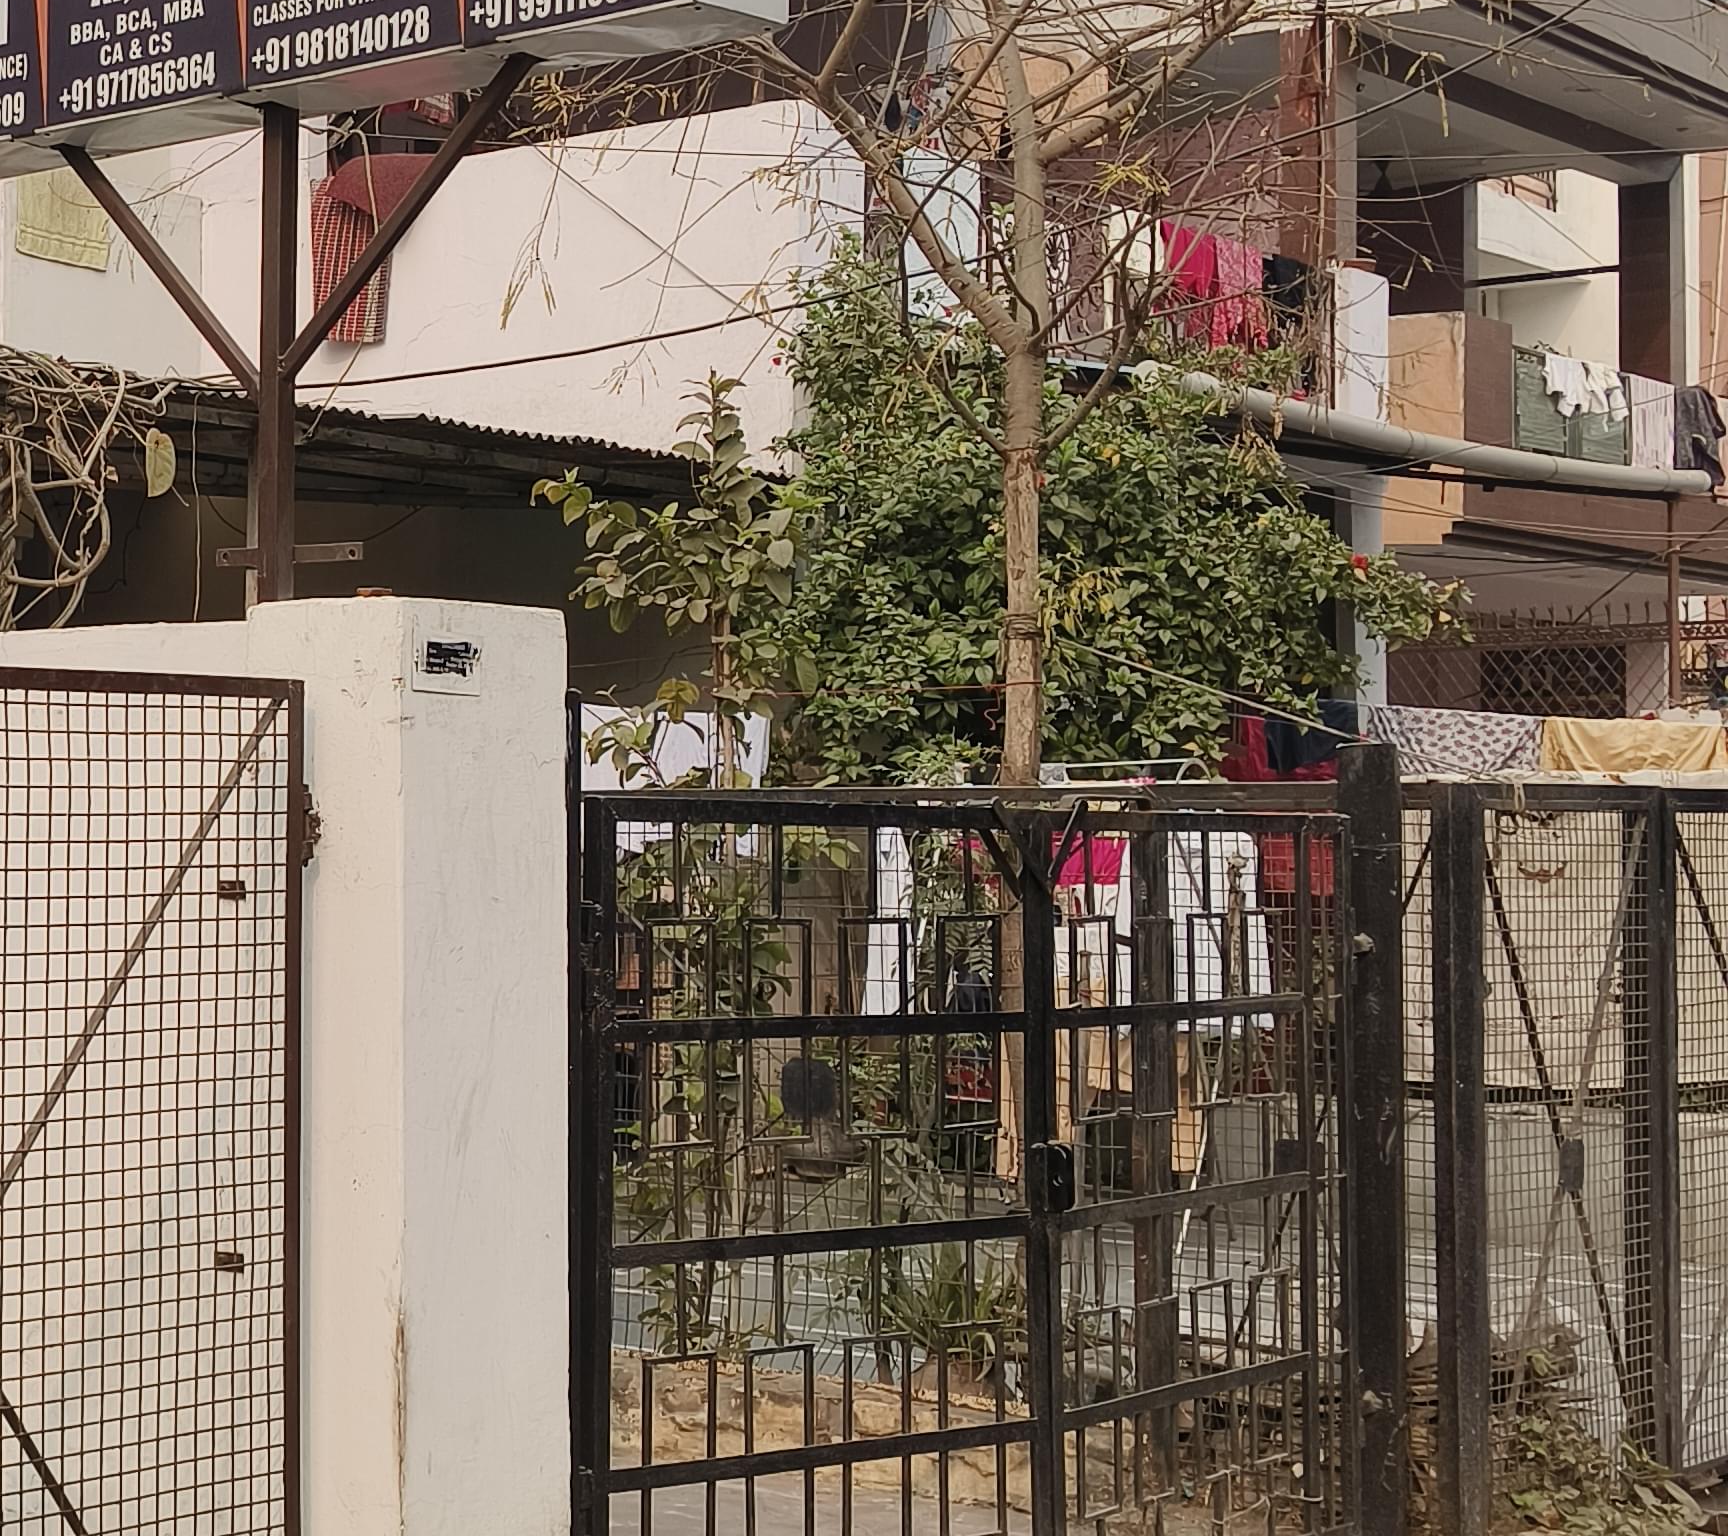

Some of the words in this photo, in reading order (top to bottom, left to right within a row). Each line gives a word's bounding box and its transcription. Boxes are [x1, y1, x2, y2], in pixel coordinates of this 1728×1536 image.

[70, 18, 111, 45] BBA,
[116, 7, 158, 35] BCA,
[99, 44, 124, 66] CA
[129, 38, 144, 60] &
[148, 31, 172, 56] CS
